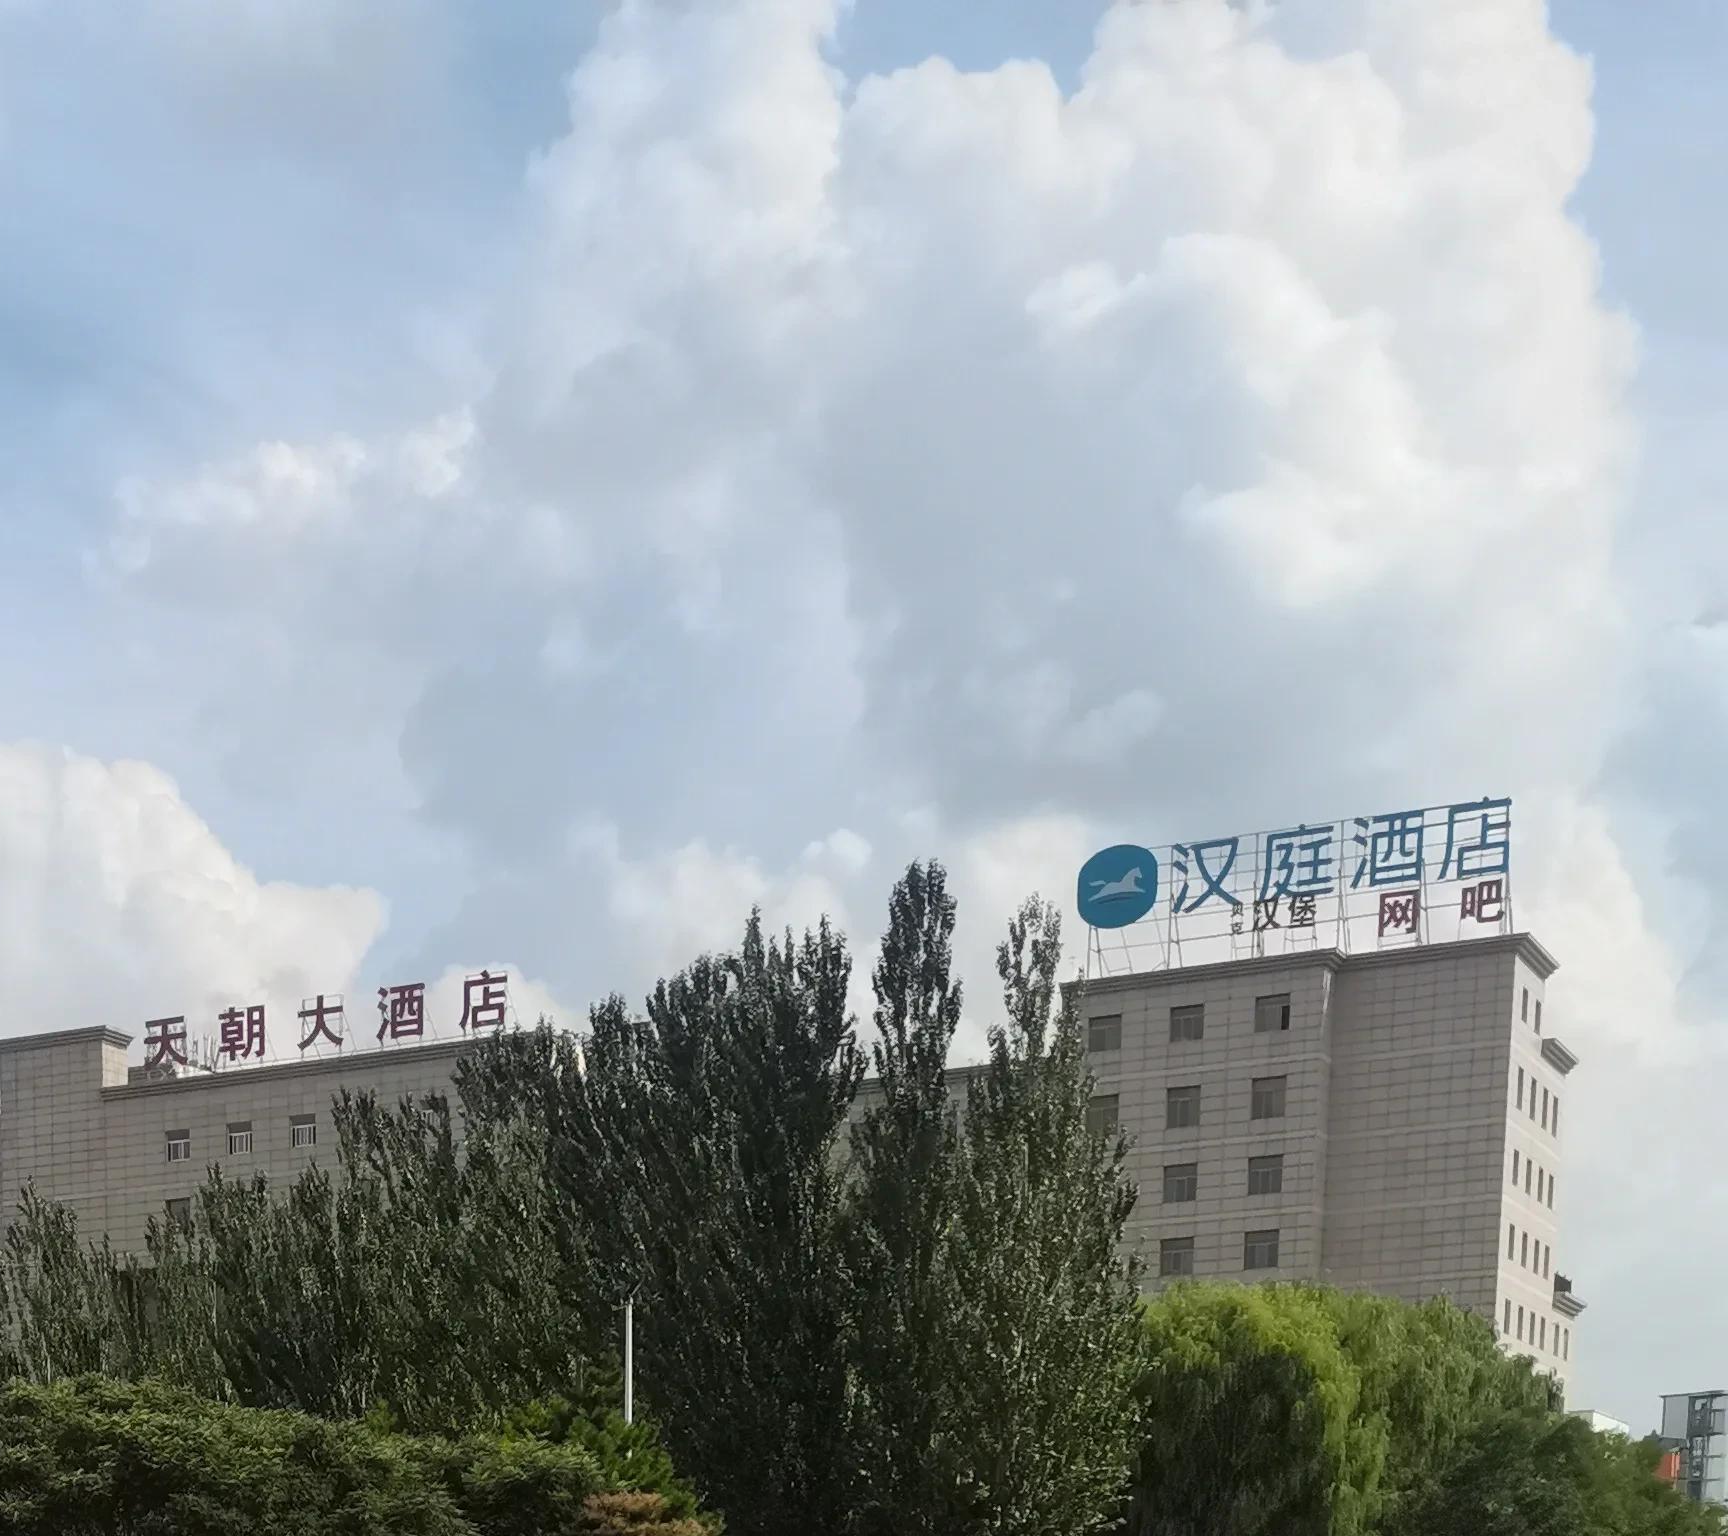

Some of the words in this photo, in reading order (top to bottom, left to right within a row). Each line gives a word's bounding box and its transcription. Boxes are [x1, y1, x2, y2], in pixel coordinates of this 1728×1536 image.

[1172, 796, 1512, 914] 汉庭酒店
[1377, 878, 1504, 937] 网吧
[143, 969, 508, 1066] 天朝大酒店
